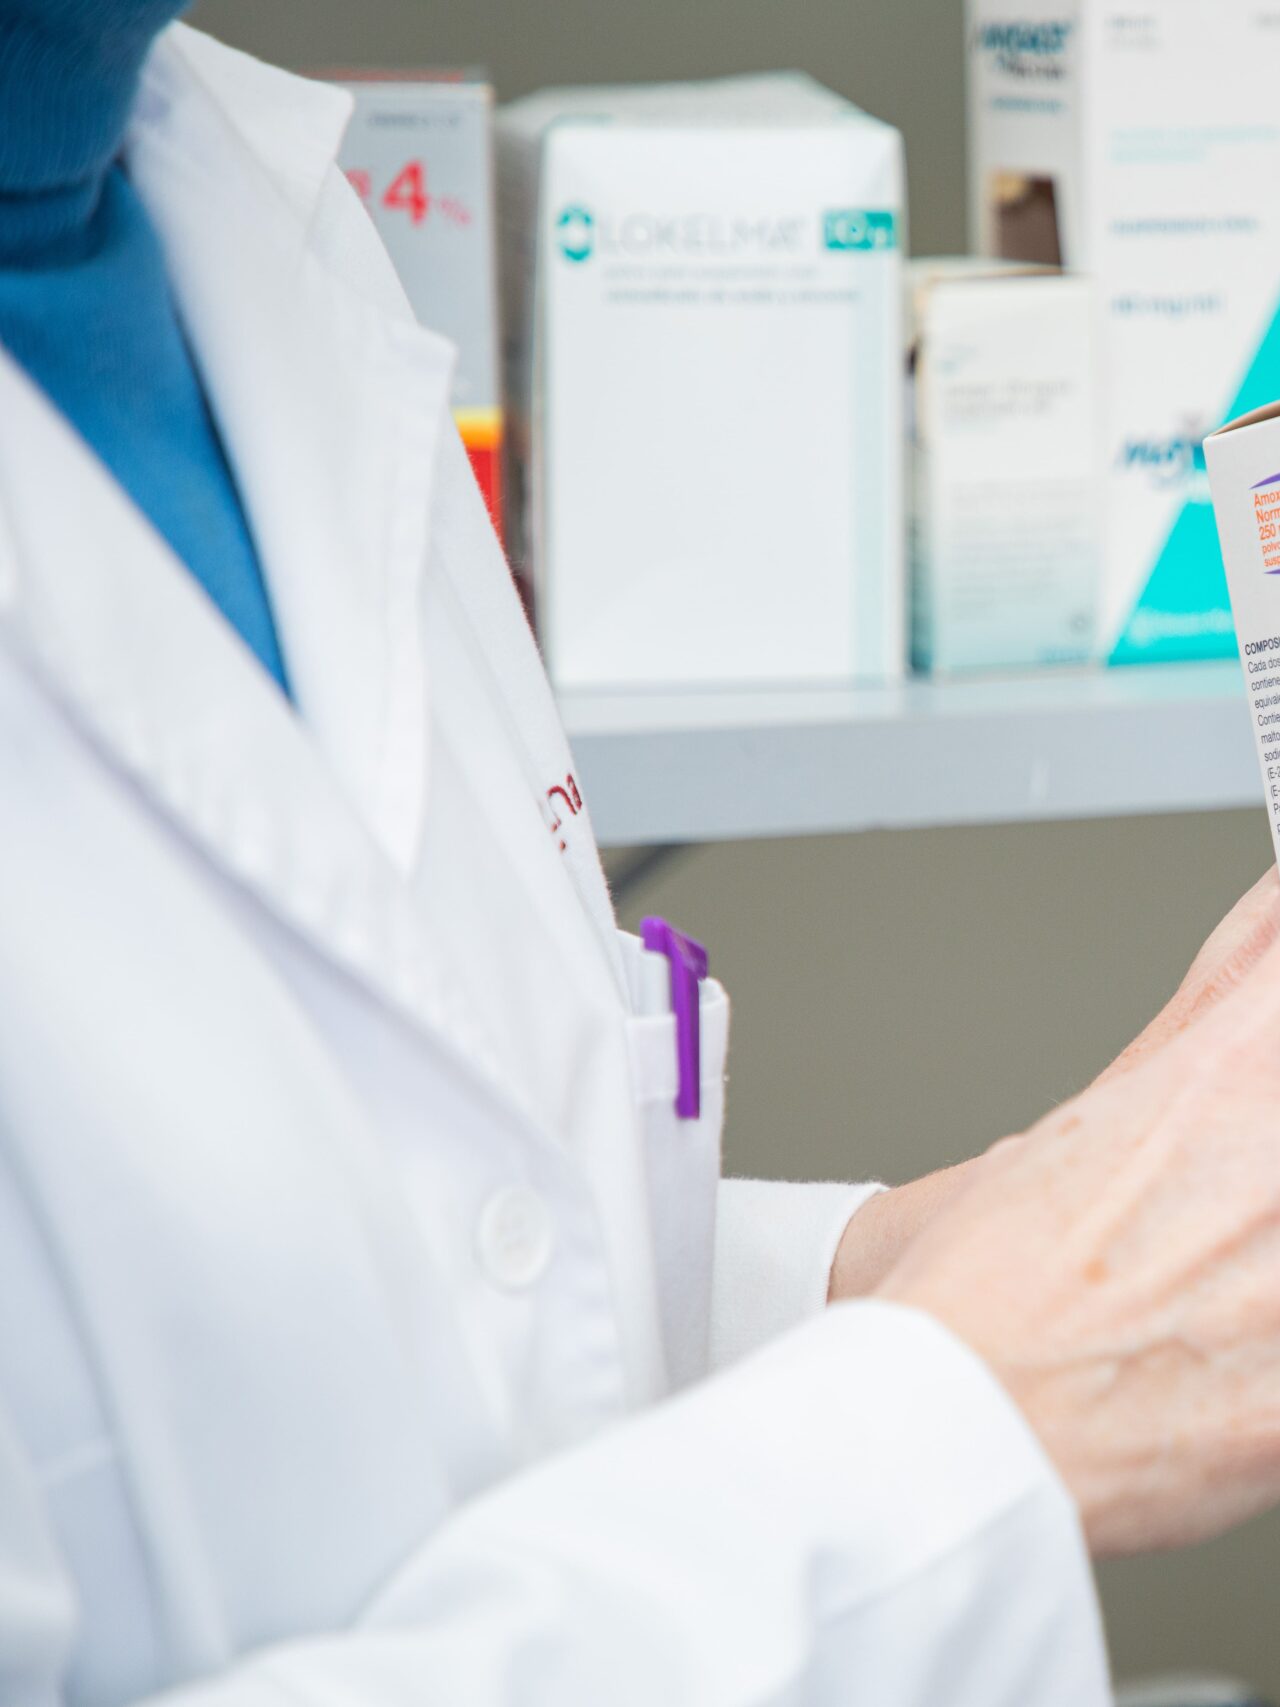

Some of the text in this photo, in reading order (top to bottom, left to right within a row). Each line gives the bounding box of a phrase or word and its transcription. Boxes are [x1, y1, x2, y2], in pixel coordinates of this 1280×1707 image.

[1259, 523, 1276, 541] 250
[1262, 542, 1280, 555] polvo
[1248, 660, 1266, 673] Cada
[1251, 676, 1280, 691] contiene
